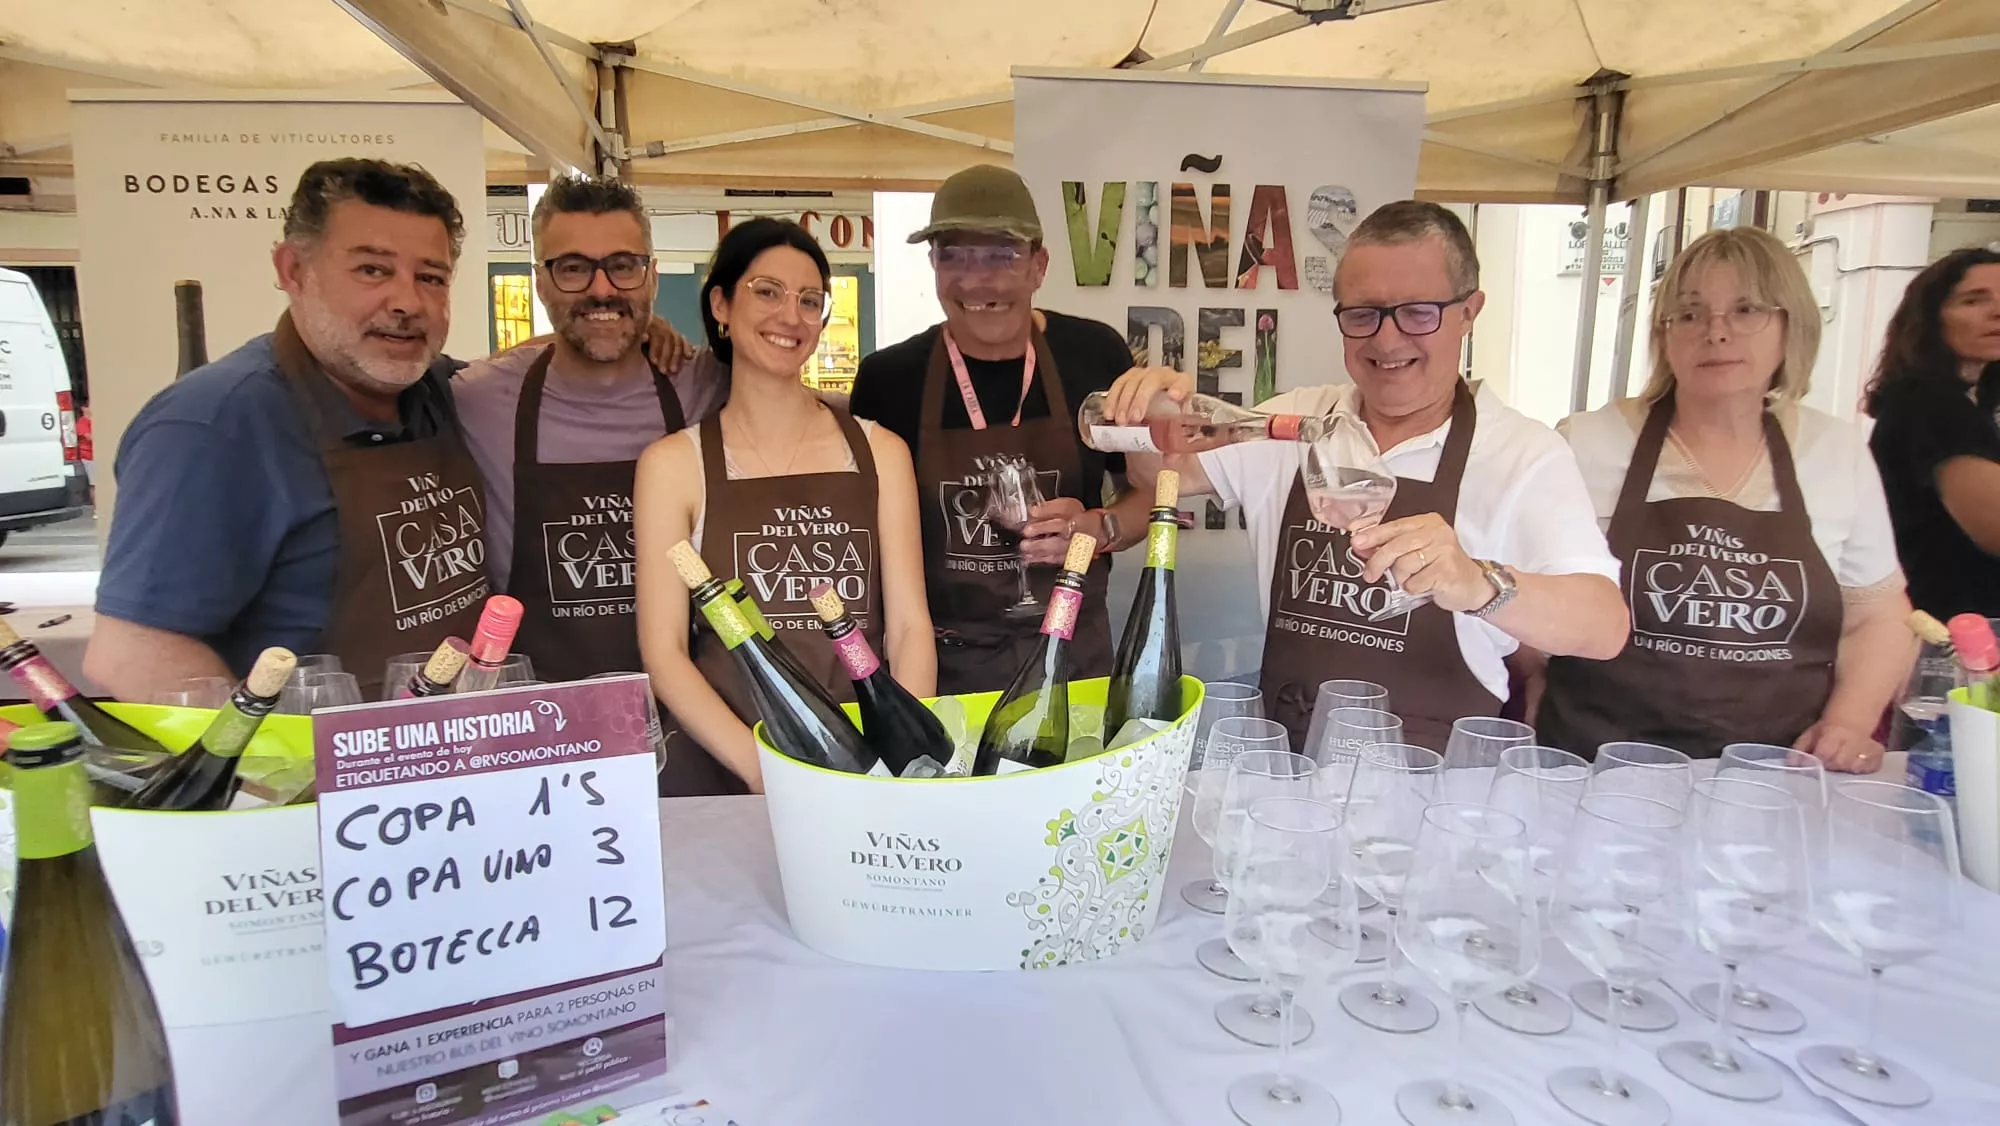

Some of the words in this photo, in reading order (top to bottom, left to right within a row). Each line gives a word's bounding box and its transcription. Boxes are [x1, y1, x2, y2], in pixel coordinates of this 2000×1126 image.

[160, 133, 231, 143] FAMILIA
[240, 133, 260, 144] DE
[271, 133, 396, 145] VITICULTORES
[124, 174, 279, 194] BODEGAS
[246, 206, 259, 220] &
[1061, 153, 1357, 296] VIÑAS
[571, 513, 608, 526] DEL
[774, 505, 833, 521] VIÑAS
[762, 524, 798, 537] DEL
[798, 522, 850, 536] VERO
[1304, 519, 1333, 534] DEL
[1687, 524, 1744, 549] VIÑAS
[747, 540, 866, 574] CASA
[1669, 543, 1709, 558] DEL
[1707, 547, 1769, 565] VERO
[1289, 569, 1394, 618] VERO
[1646, 561, 1794, 602] CASA
[396, 615, 418, 631] UN
[419, 606, 444, 624] RÍO
[552, 606, 571, 618] UN
[573, 604, 595, 617] RÍO
[598, 604, 616, 616] DE
[1643, 591, 1788, 635] VERO
[786, 619, 805, 630] DE
[1301, 622, 1318, 636] DE
[1319, 626, 1405, 653] EMOCIONES
[1634, 635, 1652, 649] UN
[1656, 638, 1682, 653] RÍO
[1685, 644, 1706, 658] DE
[1710, 647, 1793, 662] EMOCIONES
[333, 727, 392, 757] SUBE
[395, 721, 440, 749] UNA
[443, 709, 536, 743] HISTORIA
[336, 759, 450, 788] ETIQUETANDO
[454, 757, 467, 771] A
[469, 739, 601, 770] @RVSOMONTANO
[337, 758, 380, 769] Durante
[384, 753, 394, 763] el
[398, 751, 433, 761] evento
[436, 747, 450, 757] de
[453, 744, 473, 755] hoy
[336, 796, 475, 850] COPA
[866, 831, 940, 852] VIÑAS
[332, 857, 461, 921] COPA
[484, 844, 552, 883] VINO
[592, 826, 625, 865] 3
[851, 851, 894, 869] DEL
[895, 853, 963, 874] VERO
[221, 867, 317, 891] VIÑAS
[866, 873, 946, 887] SOMONTANO
[205, 896, 262, 915] DEL
[589, 895, 638, 932] 12
[350, 1051, 359, 1065] Y
[364, 1041, 410, 1061] GANA
[416, 1037, 422, 1048] 1
[428, 1015, 513, 1046] EXPERIENCIA
[517, 1005, 552, 1024] PARA
[556, 1002, 565, 1014] 2
[568, 985, 635, 1012] PERSONAS
[638, 978, 656, 992] EN
[377, 1051, 446, 1077] NUESTRO
[508, 1025, 543, 1044] VINO
[547, 1001, 637, 1035] SOMONTANO
